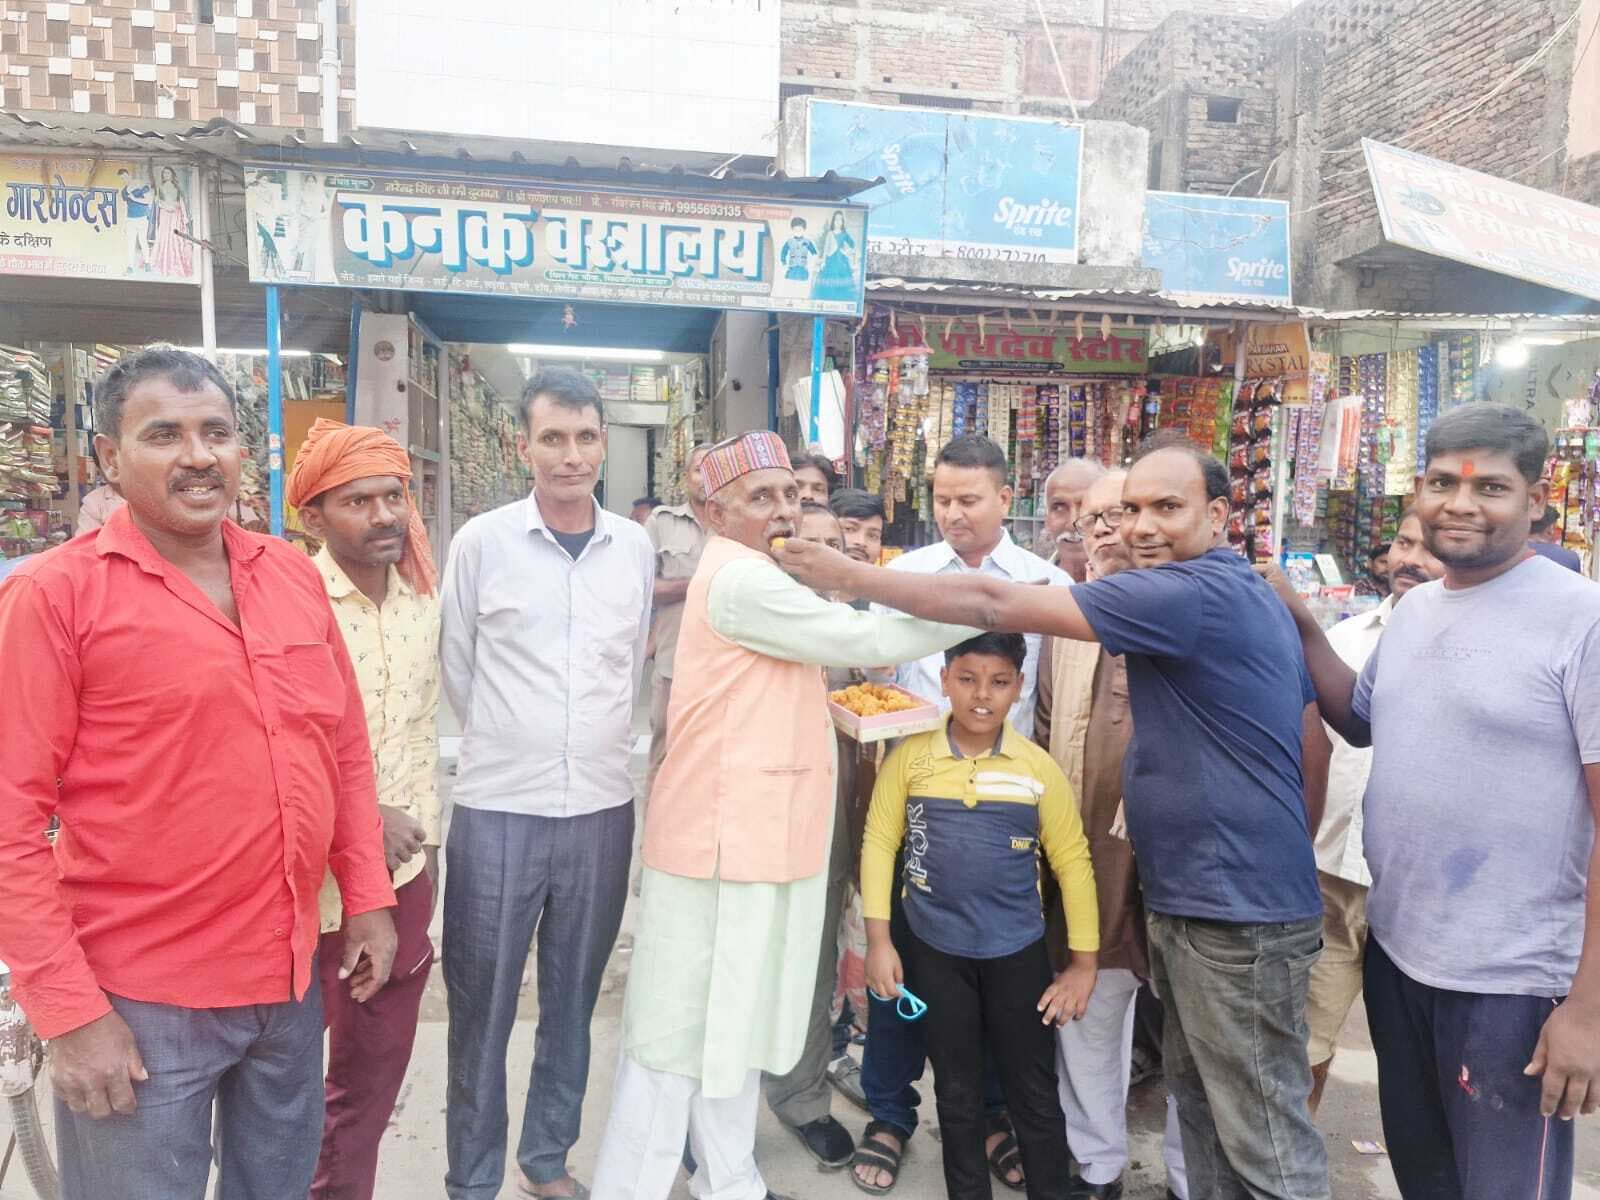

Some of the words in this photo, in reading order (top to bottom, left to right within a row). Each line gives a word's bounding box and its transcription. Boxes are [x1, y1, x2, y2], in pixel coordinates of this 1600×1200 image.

[677, 201, 742, 218] 9955693135
[992, 196, 1073, 230] Sprite
[14, 232, 53, 250] दक्षिण
[337, 192, 536, 274] कनक
[1226, 256, 1285, 282] Sprite
[1246, 355, 1307, 375] RYSTAL
